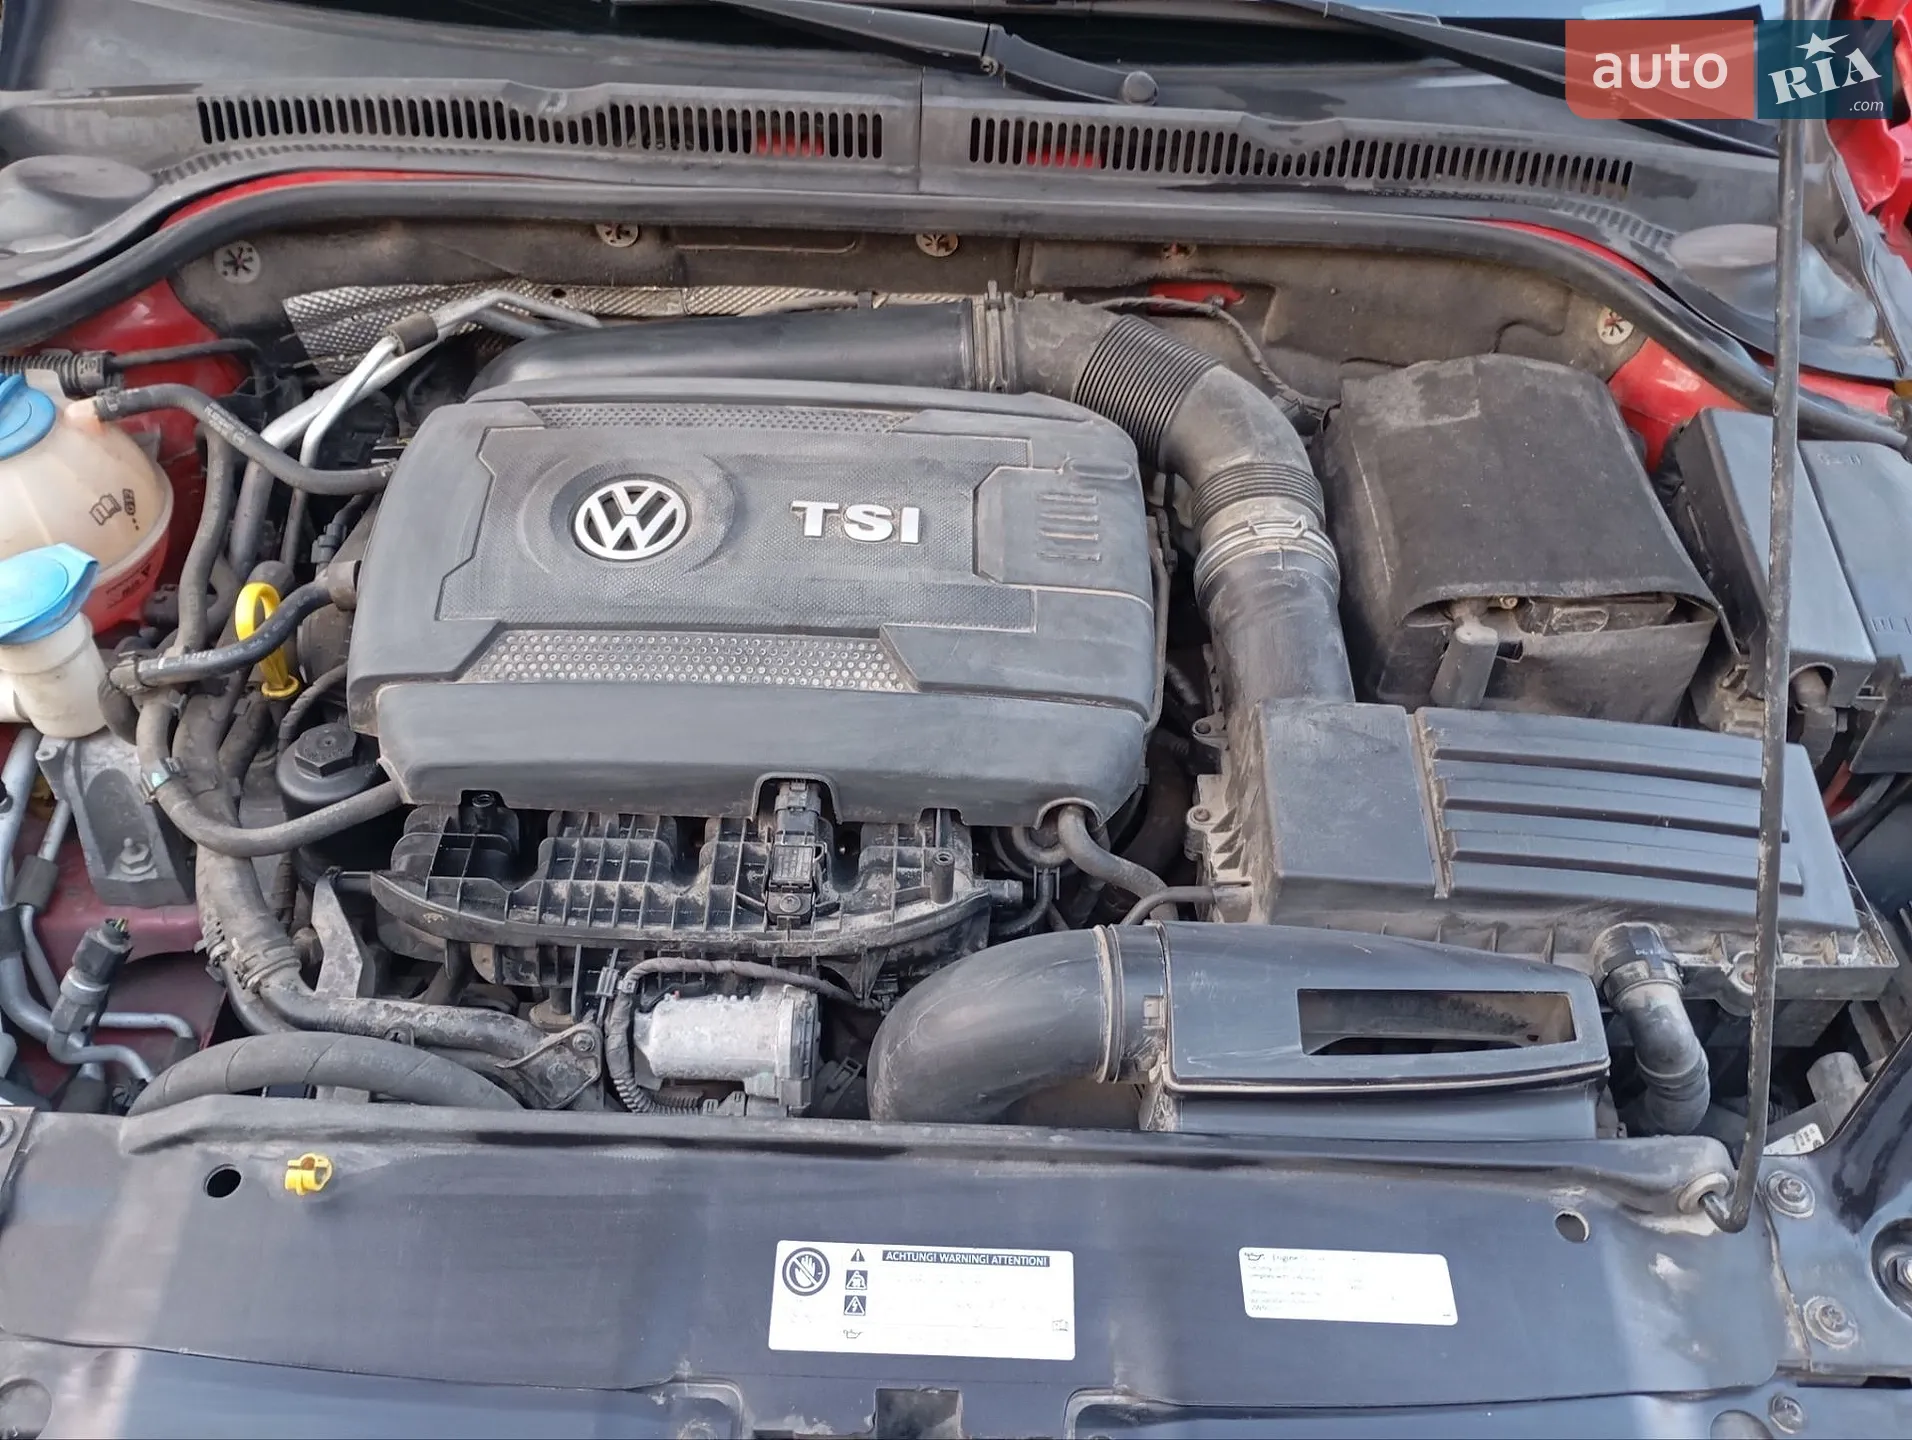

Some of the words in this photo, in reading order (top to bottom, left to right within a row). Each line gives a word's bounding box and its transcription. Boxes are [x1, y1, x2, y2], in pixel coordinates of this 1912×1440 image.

[574, 479, 687, 560] VW
[790, 500, 921, 545] TSI
[885, 1250, 937, 1262] ACHTUNG!
[939, 1252, 989, 1264] WARNING!
[991, 1254, 1047, 1266] ATTENTION!
